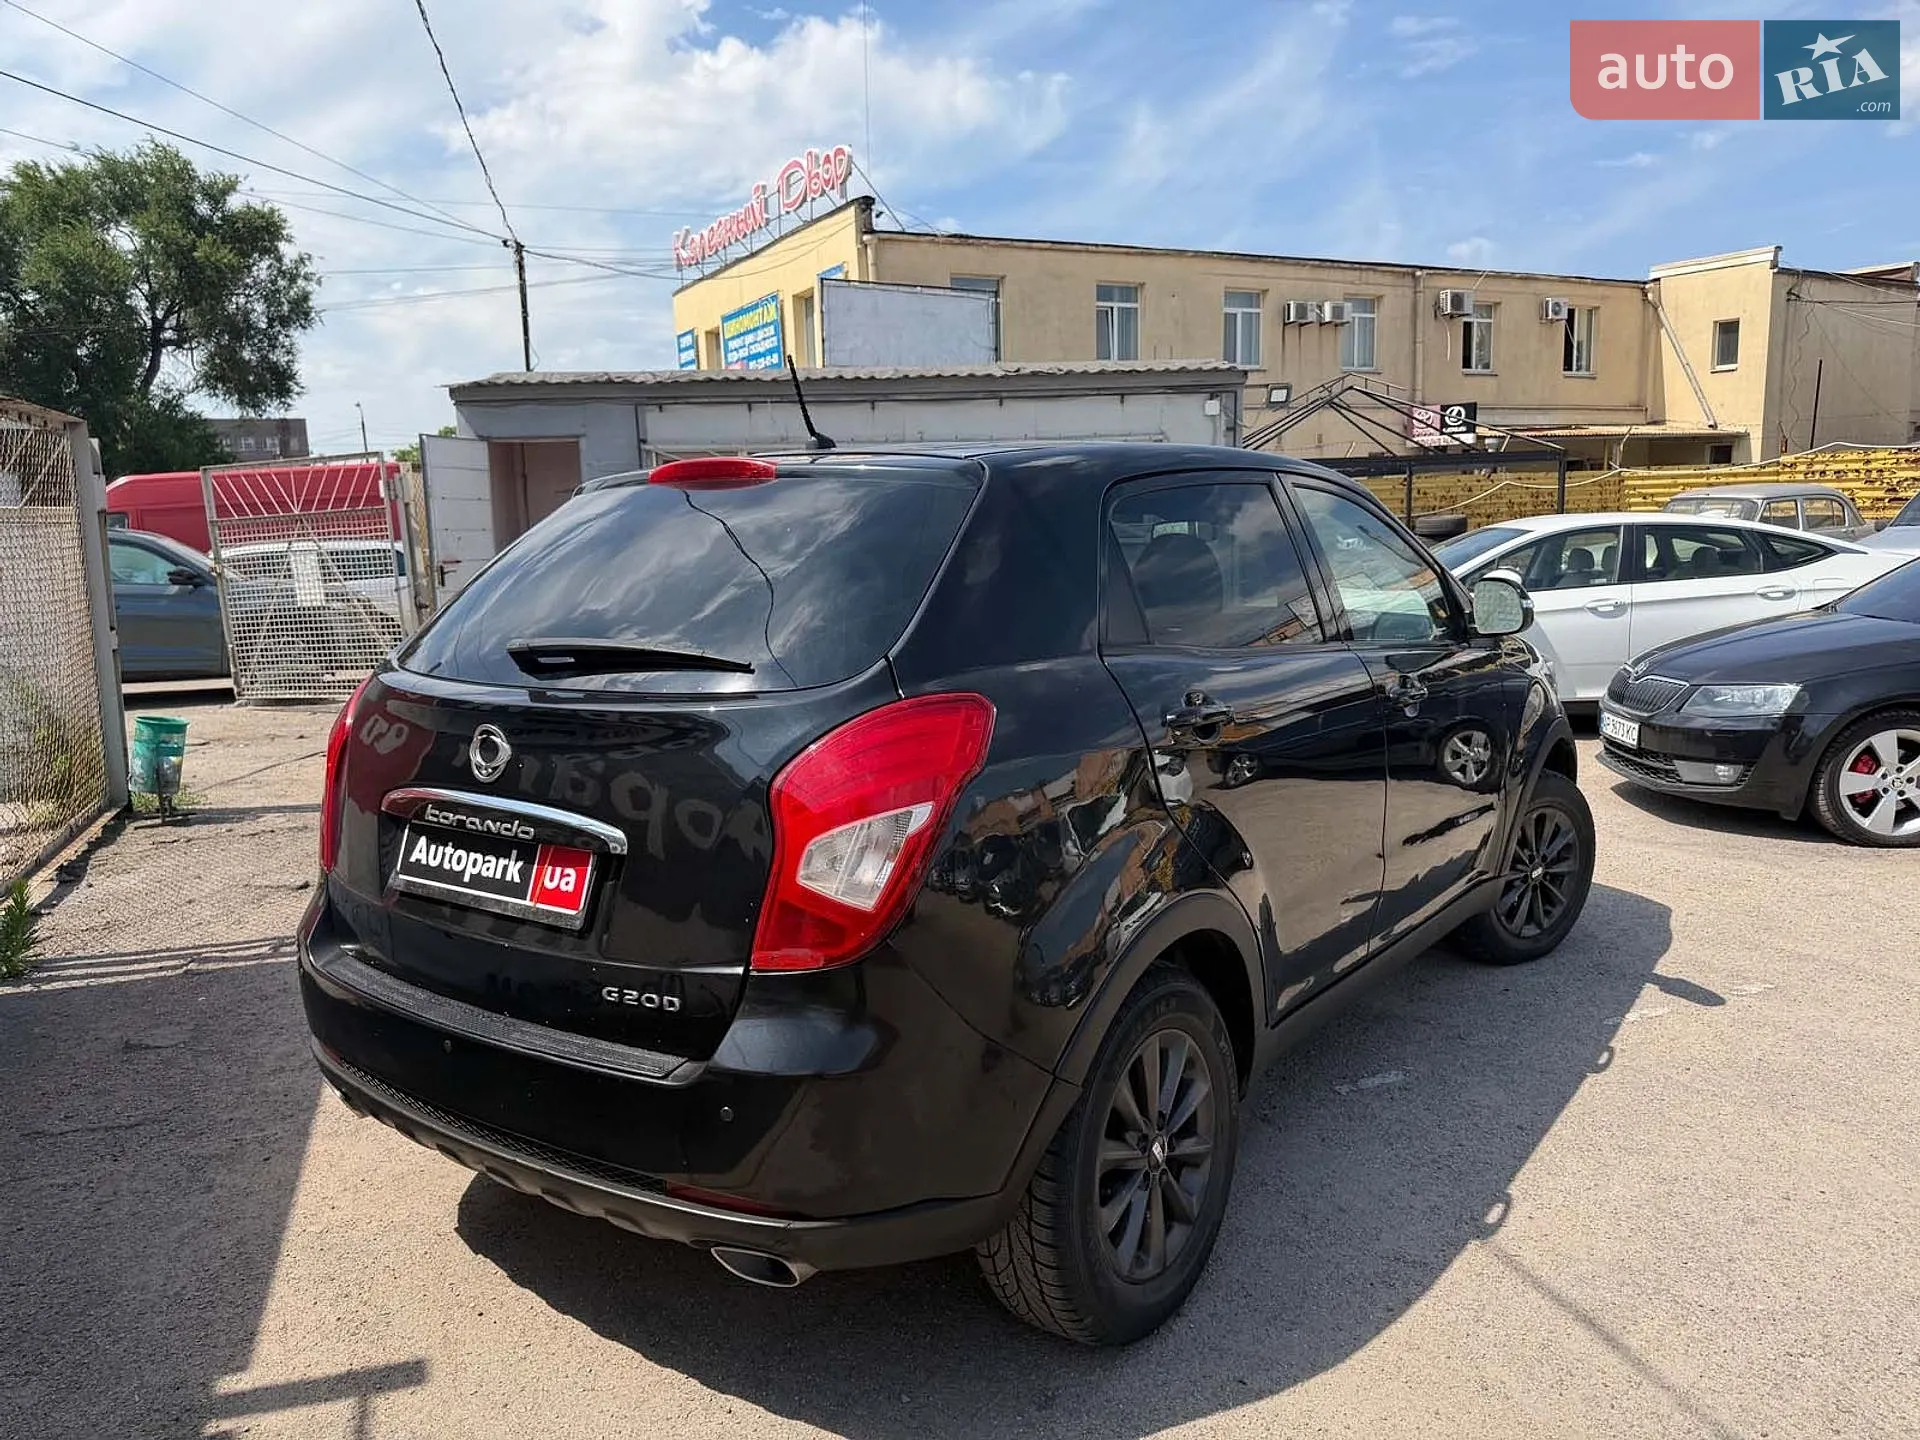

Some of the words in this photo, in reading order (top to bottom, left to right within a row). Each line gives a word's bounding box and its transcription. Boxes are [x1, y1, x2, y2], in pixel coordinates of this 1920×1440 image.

[409, 835, 524, 884] Autopark
[544, 865, 577, 893] ua
[602, 986, 681, 1012] G20D
